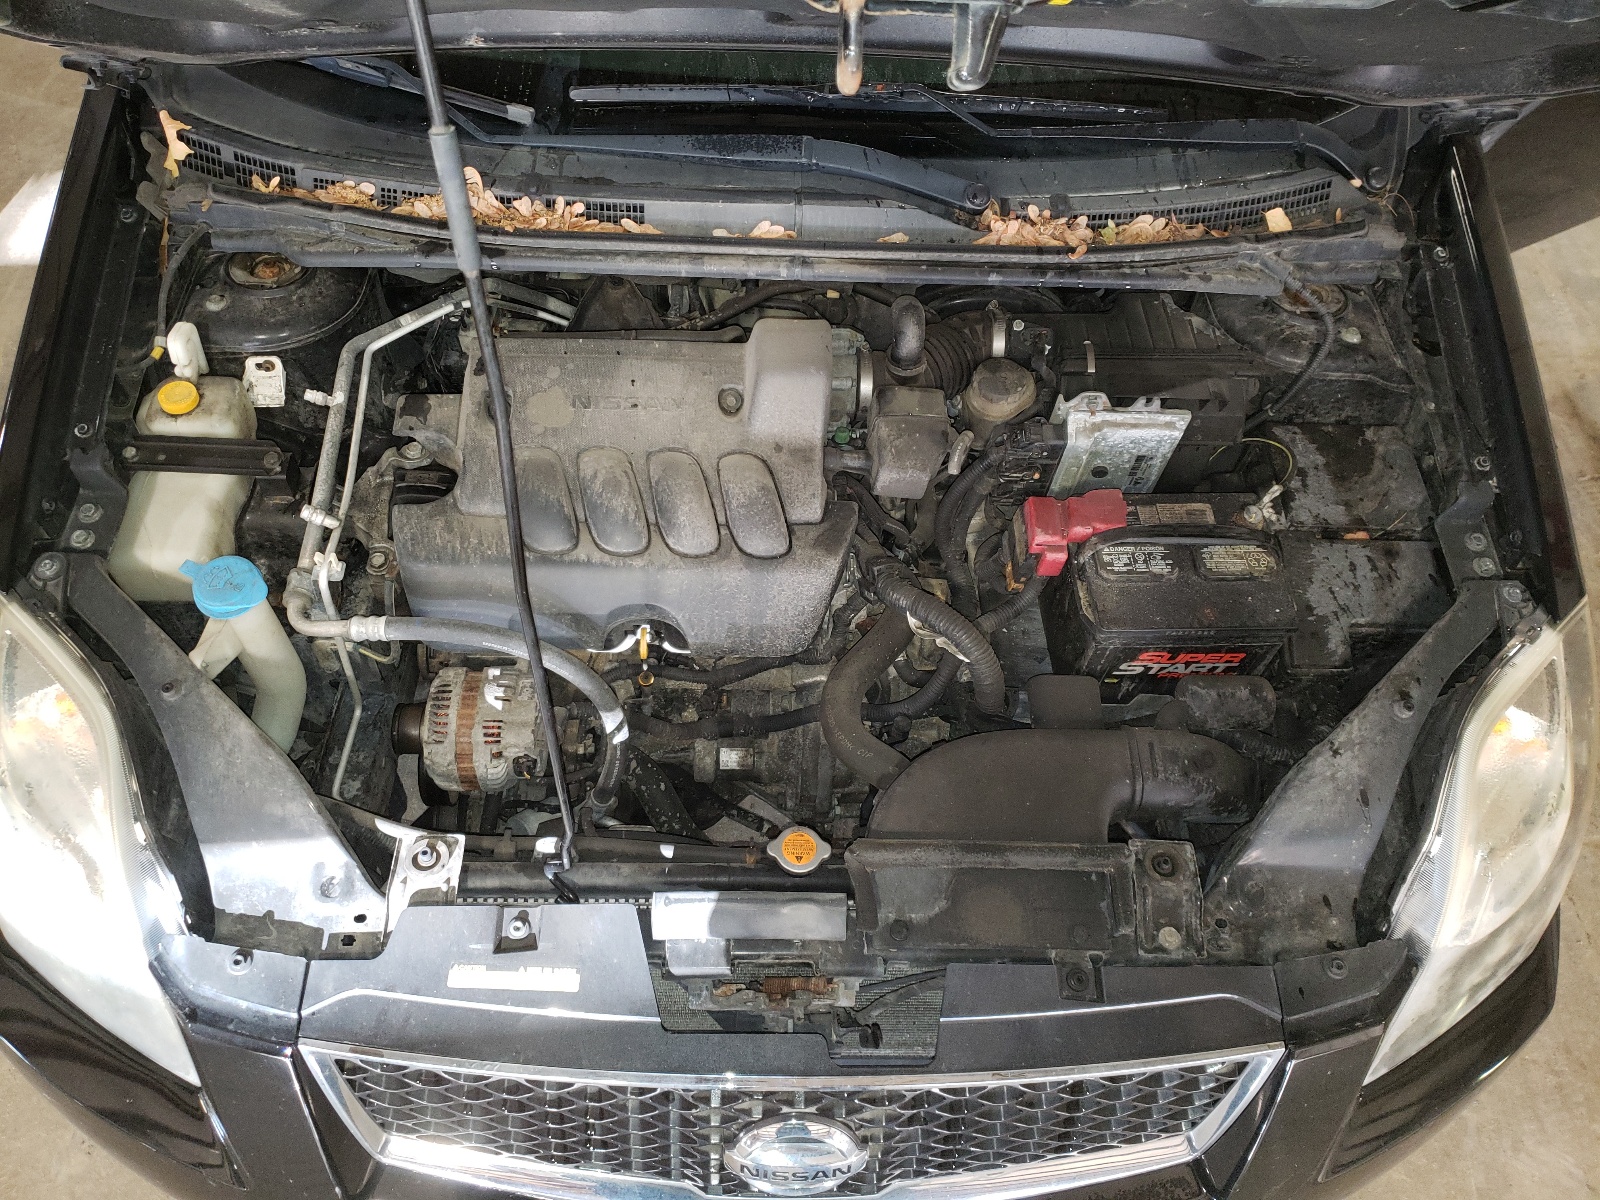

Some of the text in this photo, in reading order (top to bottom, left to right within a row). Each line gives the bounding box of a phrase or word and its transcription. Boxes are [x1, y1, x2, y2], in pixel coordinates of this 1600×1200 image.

[1131, 651, 1247, 664] SUPER
[1112, 661, 1240, 675] START
[740, 1164, 851, 1182] NISSAN
